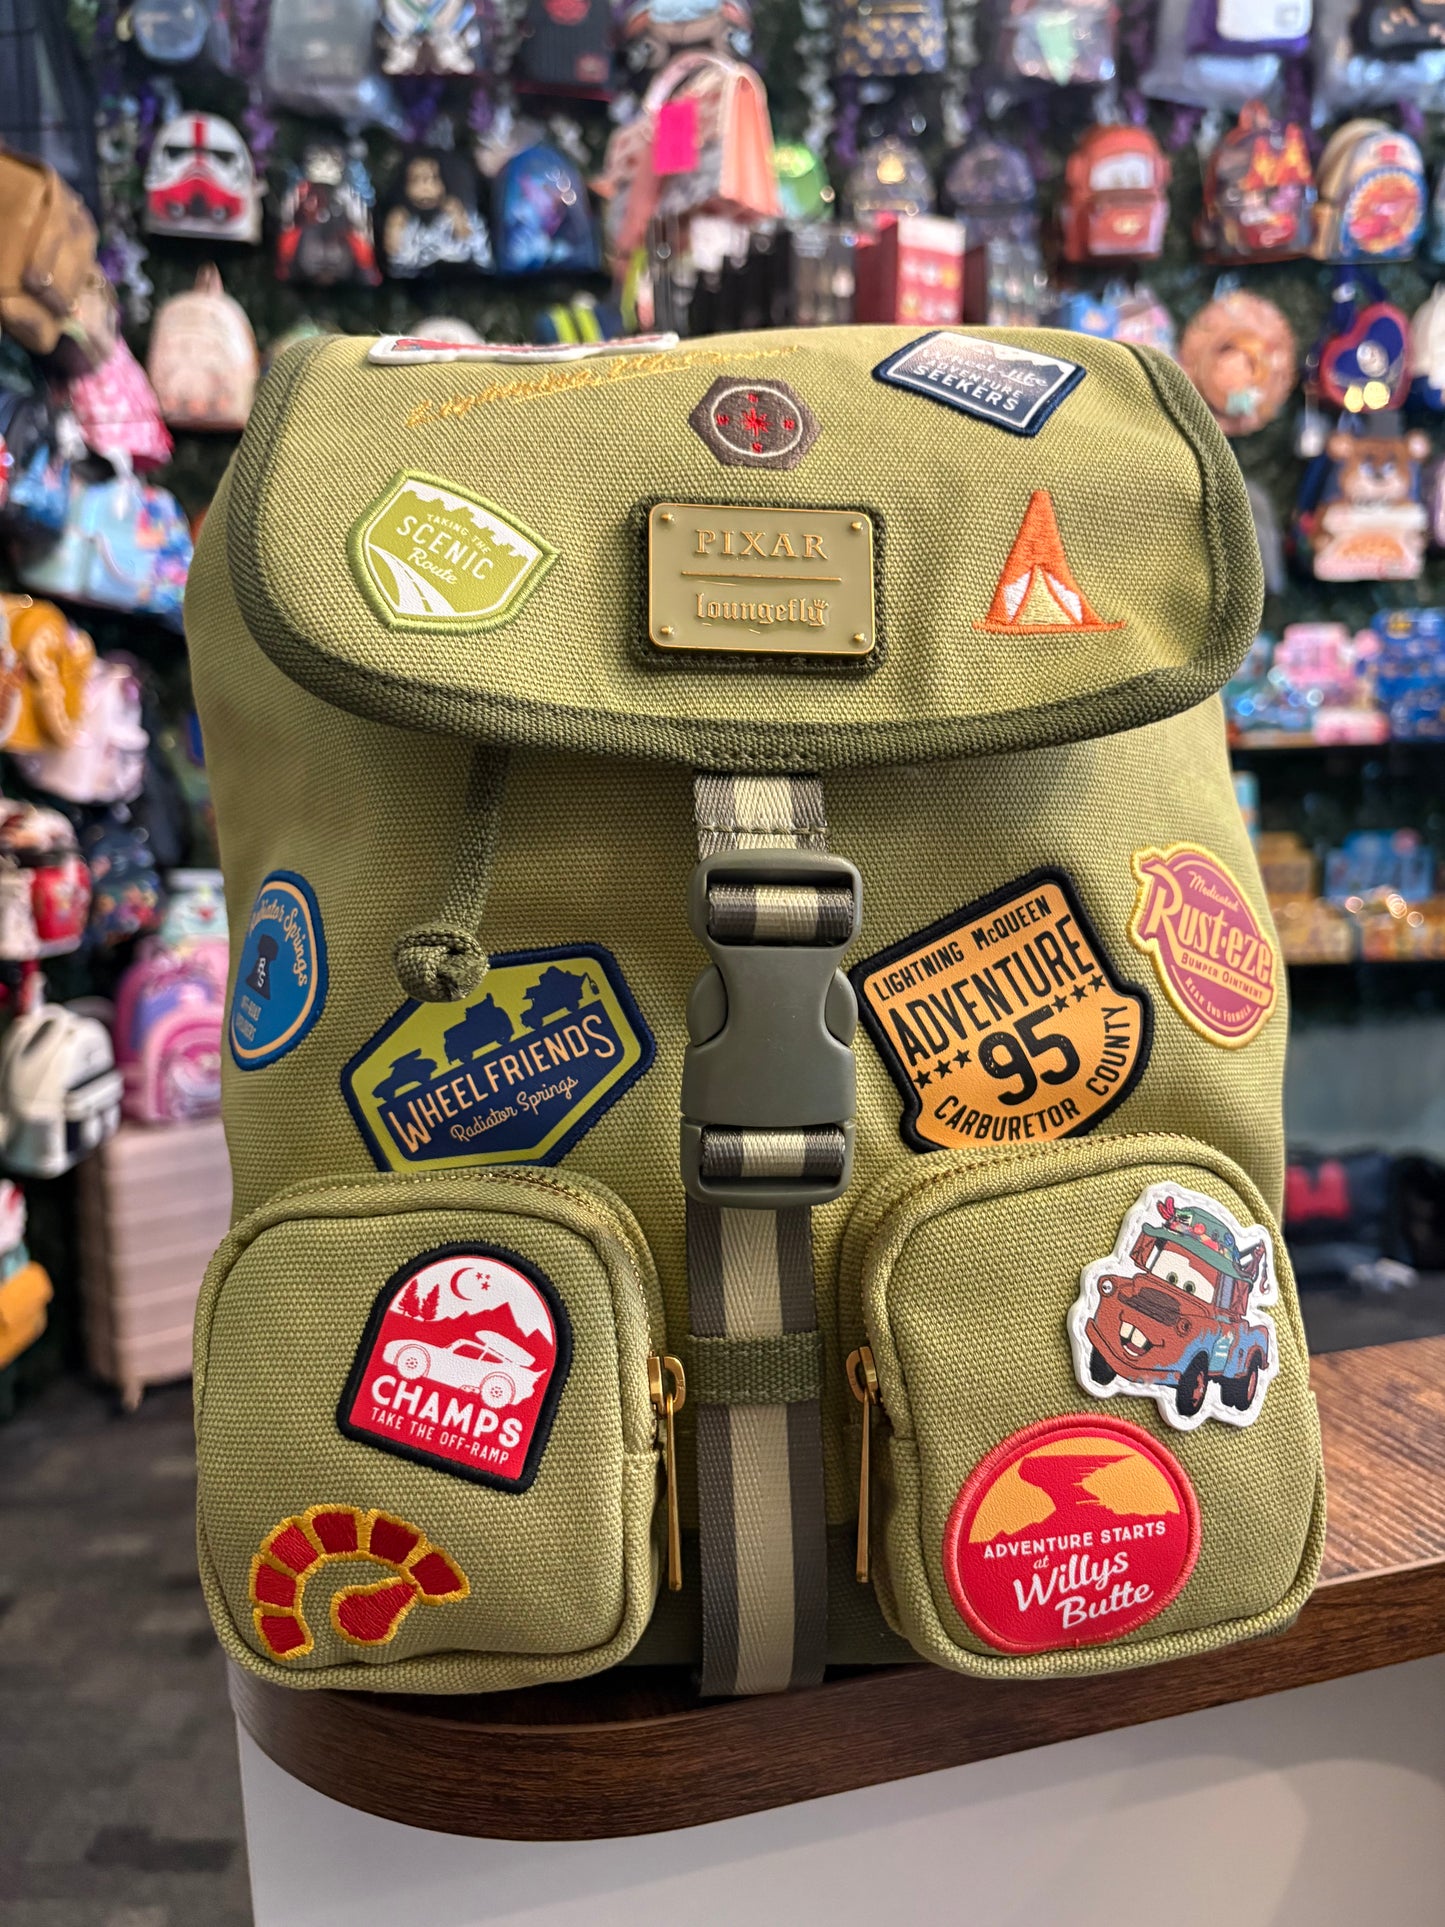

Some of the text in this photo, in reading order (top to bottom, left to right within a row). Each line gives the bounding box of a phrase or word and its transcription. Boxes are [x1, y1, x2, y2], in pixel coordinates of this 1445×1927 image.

[913, 365, 1020, 411] SEEKERS
[926, 360, 1023, 398] ADVENTURE
[396, 515, 493, 580] SCENIC
[427, 514, 492, 555] TAKING THE
[695, 528, 828, 560] PIXAR
[407, 547, 458, 585] Route
[1188, 870, 1239, 912] Medicated
[283, 907, 308, 987] Springs
[873, 895, 1052, 1001] LIGHTNING McQUEEN
[889, 914, 1095, 1066] ADVENTURE
[934, 1005, 1130, 1142] CARBURETOR COUNTY
[978, 1004, 1080, 1106] 95
[450, 1074, 579, 1142] Radiator Springs
[370, 1407, 509, 1464] TAKE THE OFF-RAMP
[371, 1374, 523, 1448] CHAMPS
[983, 1520, 1166, 1559] ADVENTURE STARTS
[1033, 1557, 1050, 1570] at
[1013, 1552, 1129, 1613] Willys
[1055, 1583, 1154, 1630] Butte
